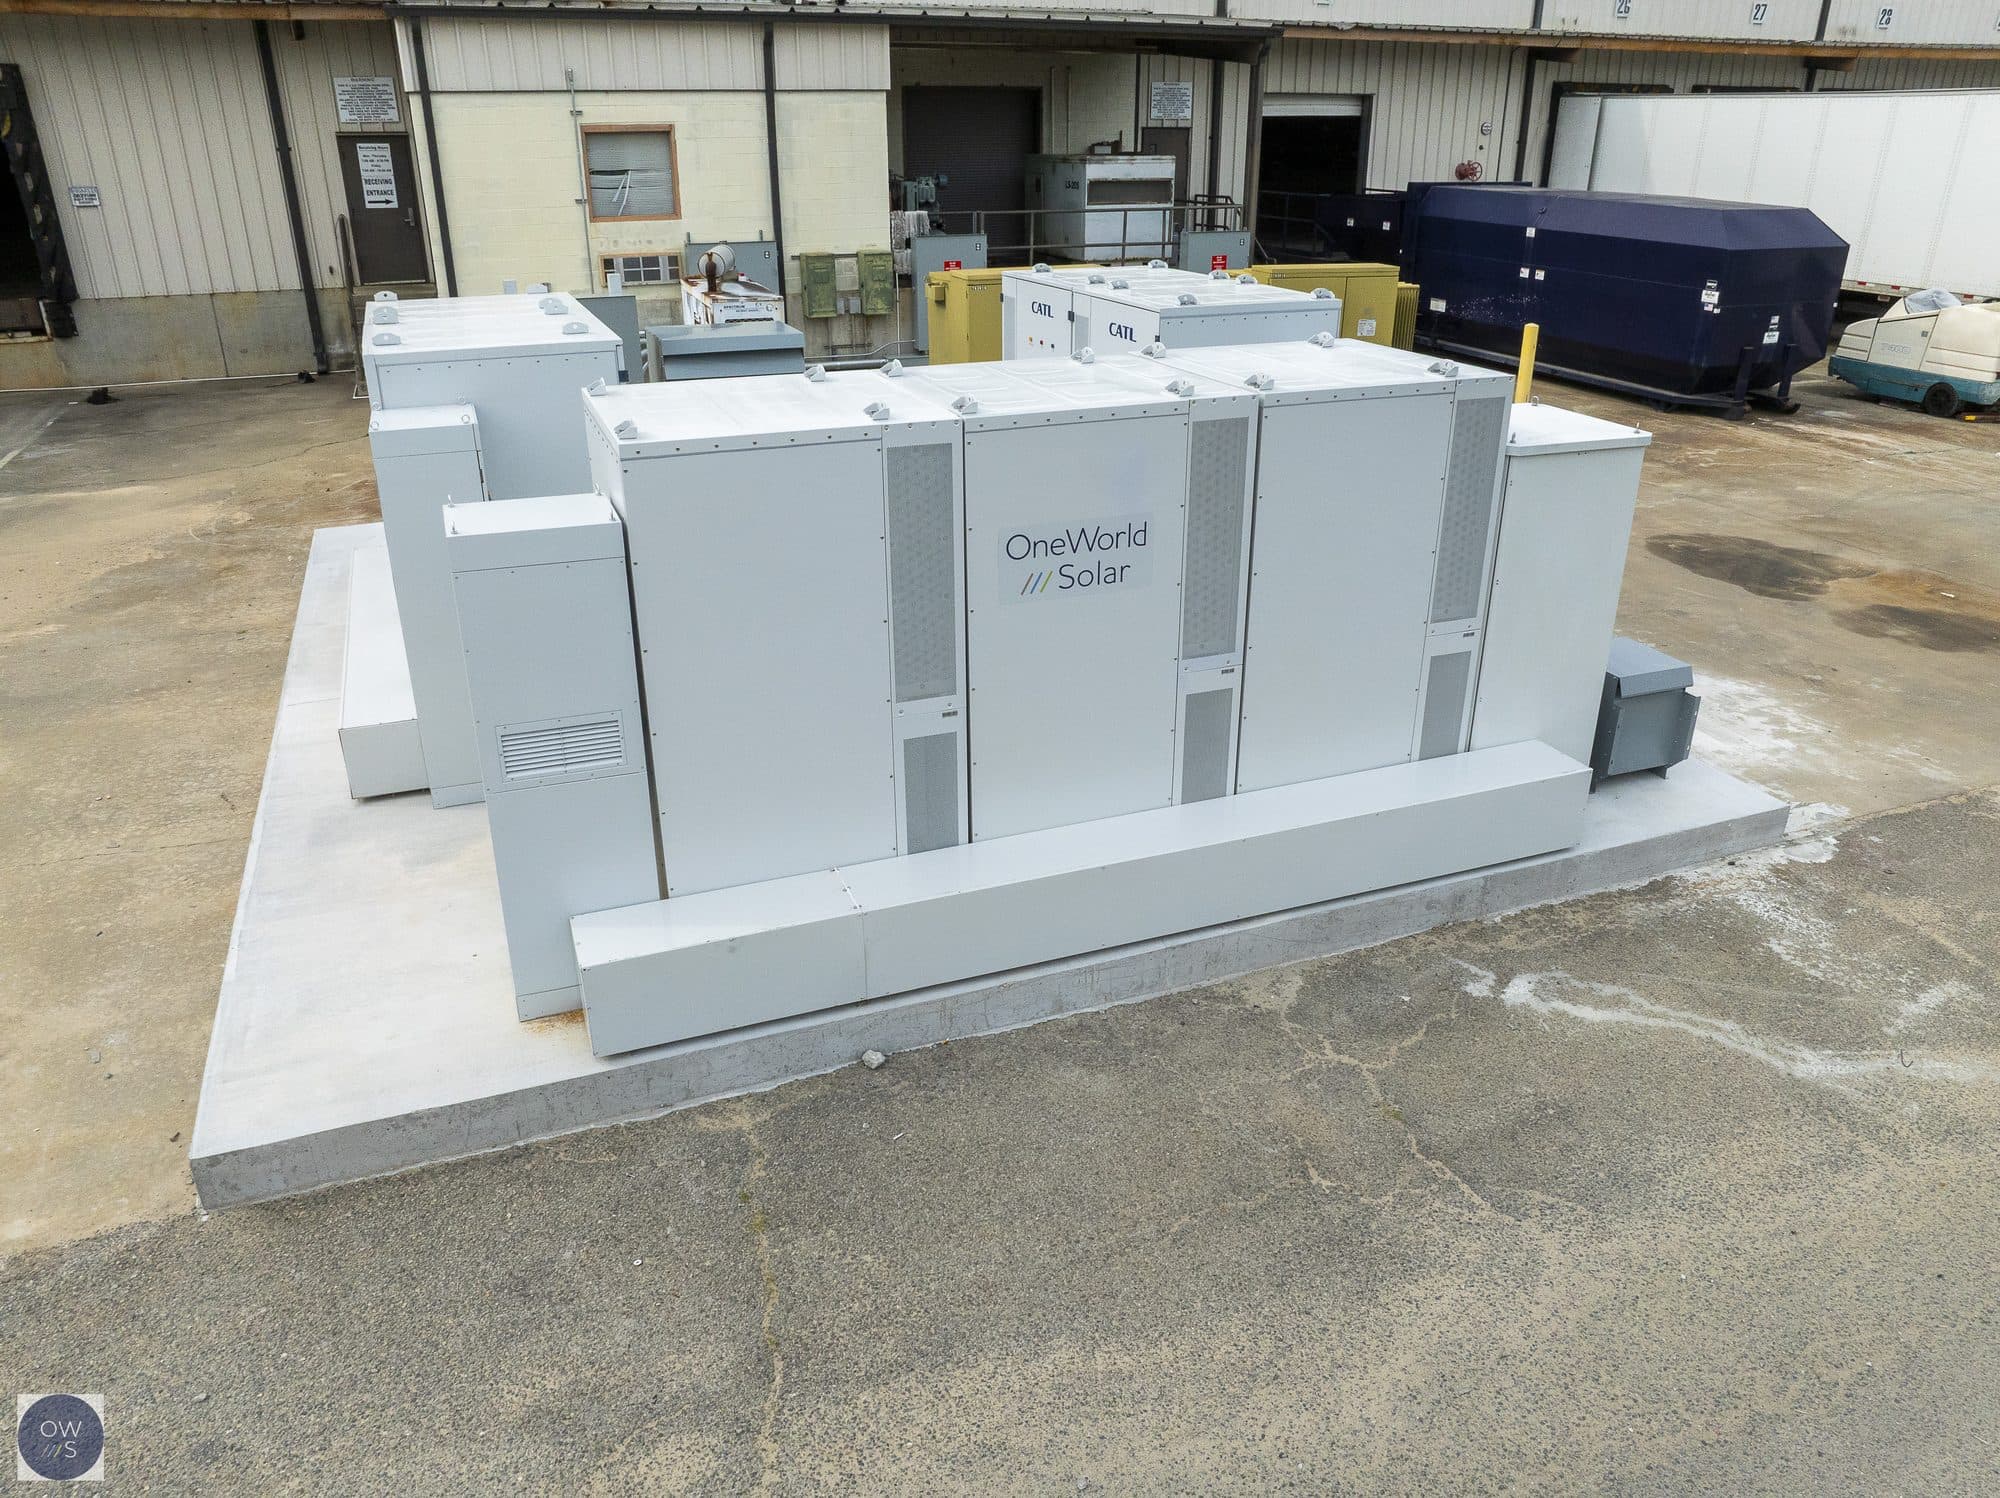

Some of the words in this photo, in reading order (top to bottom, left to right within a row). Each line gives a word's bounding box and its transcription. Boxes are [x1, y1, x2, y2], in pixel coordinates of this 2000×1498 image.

[1617, 0, 1631, 14] 26
[1753, 4, 1767, 20] 27
[1879, 9, 1893, 25] 28
[1031, 301, 1054, 318] CATL
[1109, 322, 1137, 342] CATL
[1006, 521, 1147, 560] OneWorld
[1058, 560, 1131, 589] Solar
